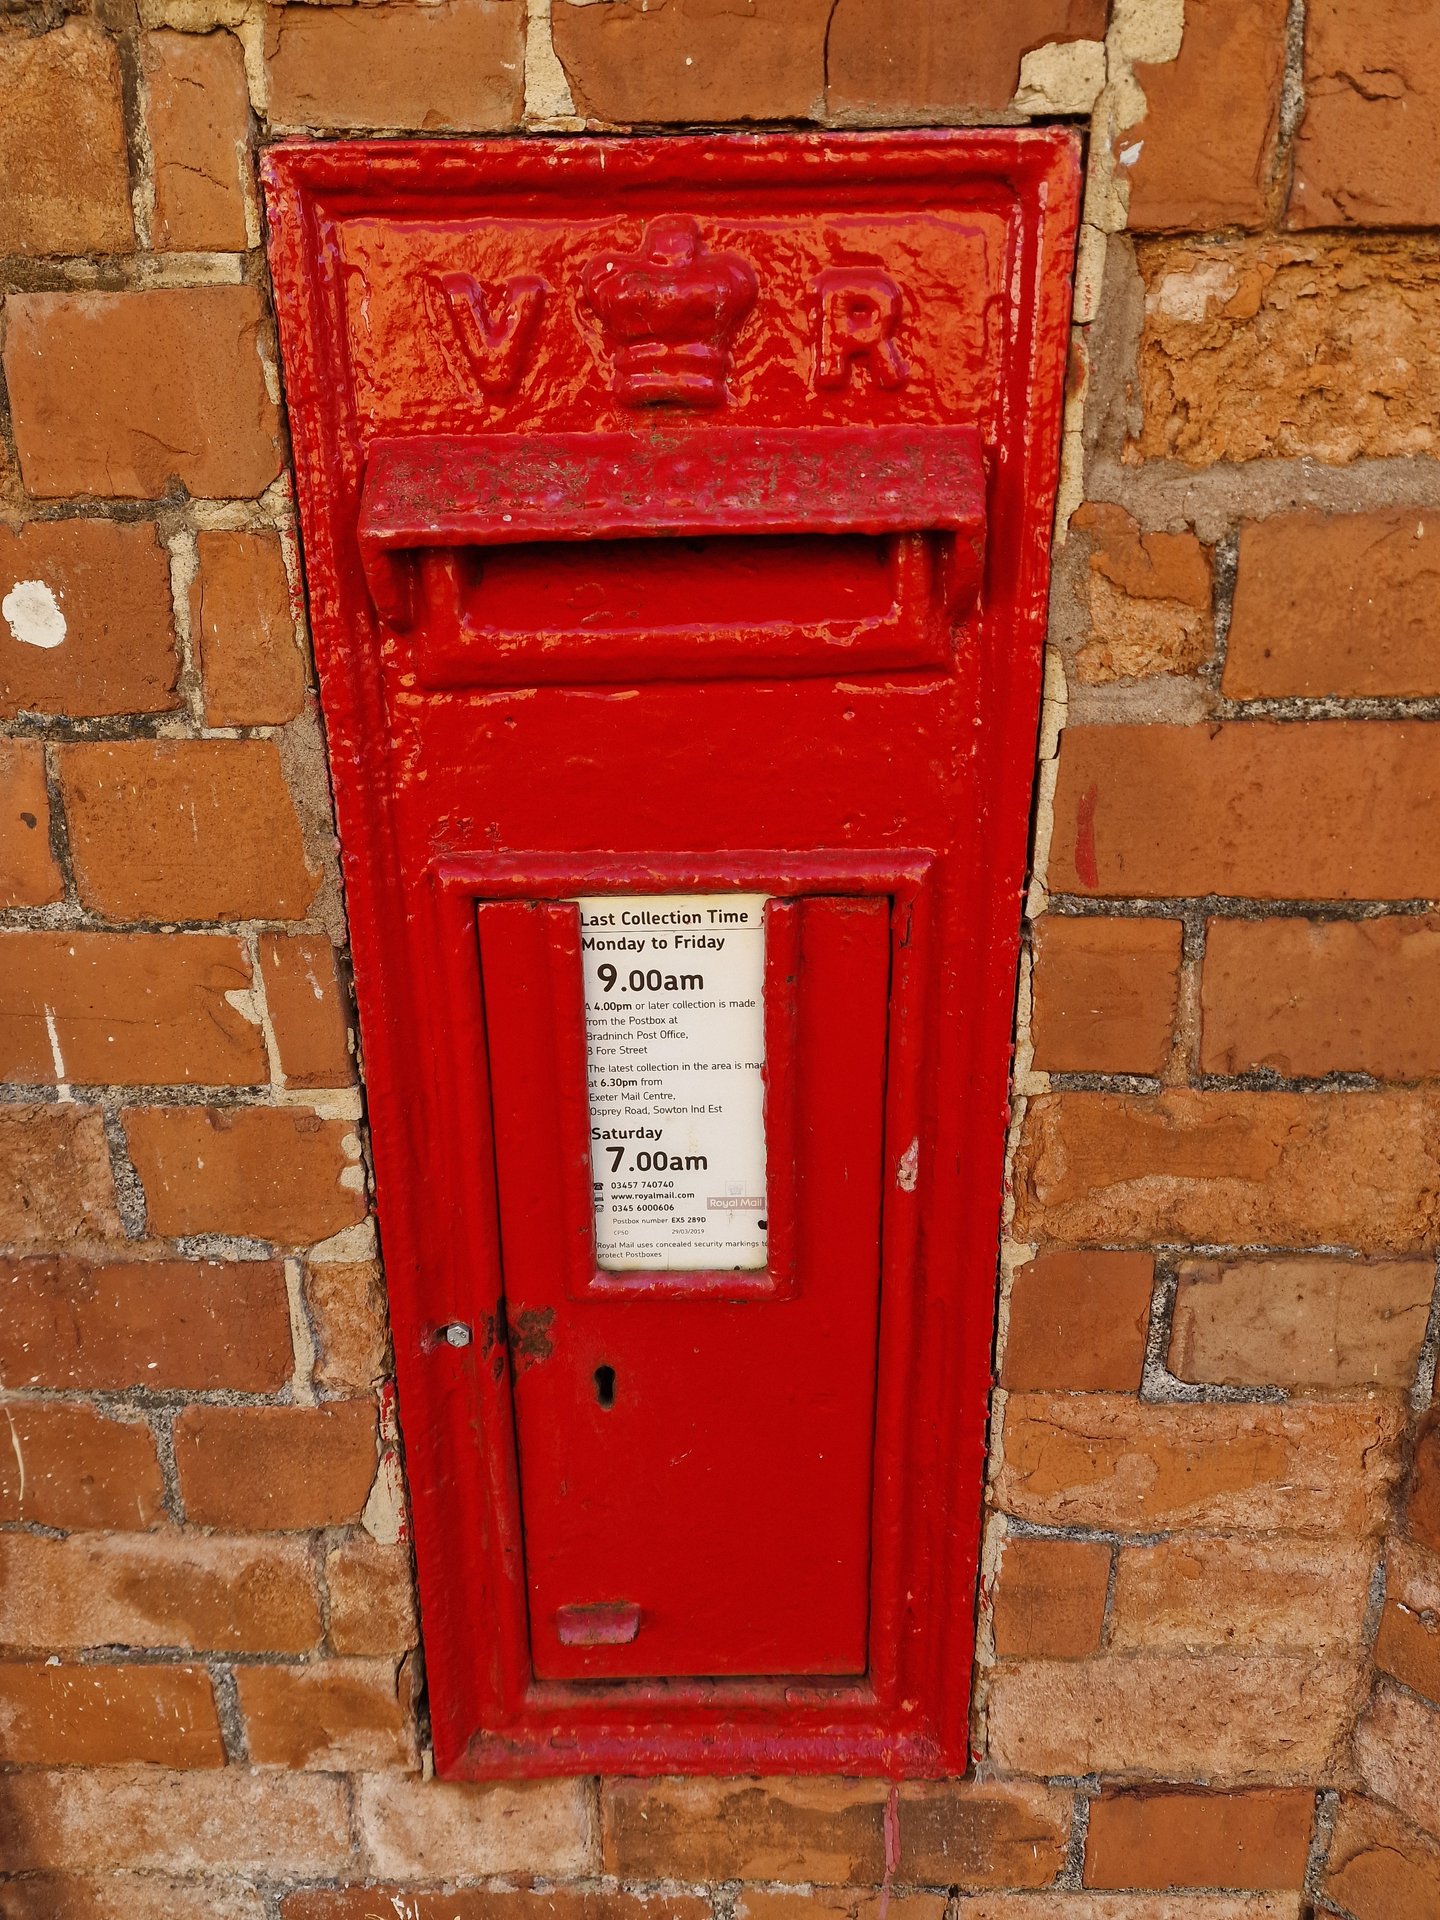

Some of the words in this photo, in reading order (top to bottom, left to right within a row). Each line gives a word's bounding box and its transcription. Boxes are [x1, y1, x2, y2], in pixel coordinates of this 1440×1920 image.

[442, 270, 546, 396] V
[811, 266, 912, 392] R
[580, 912, 615, 926] Last
[621, 911, 701, 925] Collection
[707, 909, 749, 924] Time
[581, 936, 645, 953] Monday
[651, 936, 668, 950] to
[674, 935, 725, 951] Friday
[597, 963, 704, 992] 9.00am
[585, 1002, 591, 1011] A
[594, 1001, 632, 1012] 4.00pm
[648, 1001, 670, 1010] later
[672, 1000, 716, 1009] collection
[719, 1000, 726, 1009] is
[729, 1000, 756, 1009] made
[611, 1017, 626, 1026] the
[629, 1016, 666, 1025] Postbox
[669, 1016, 678, 1025] at
[586, 1032, 634, 1041] Bradninch
[637, 1031, 657, 1040] Post
[660, 1030, 689, 1040] Office,
[596, 1046, 616, 1055] Fore
[619, 1046, 648, 1055] Street
[588, 1064, 606, 1073] The
[608, 1064, 634, 1072] latest
[636, 1063, 679, 1072] collection
[682, 1062, 690, 1071] in
[693, 1062, 708, 1071] the
[734, 1060, 742, 1069] is
[588, 1080, 598, 1088] at
[600, 1078, 638, 1089] 6.30pm
[641, 1077, 663, 1086] from
[589, 1093, 618, 1101] Exeter
[621, 1092, 640, 1100] Mail
[643, 1091, 675, 1100] Centre,
[590, 1107, 622, 1117] Osprey
[624, 1106, 650, 1116] Road,
[653, 1105, 688, 1114] Sowton
[691, 1105, 705, 1114] Ind
[708, 1105, 722, 1113] Est
[592, 1127, 663, 1141] Saturday
[606, 1146, 708, 1172] 7.00am
[611, 1181, 638, 1189] 03457
[641, 1181, 674, 1189] 740740
[611, 1191, 695, 1200] www.royalmail.com
[612, 1204, 634, 1212] 0345
[636, 1204, 674, 1212] 6000606
[710, 1199, 737, 1208] Royal
[740, 1198, 762, 1207] Mail
[725, 1240, 759, 1248] markings
